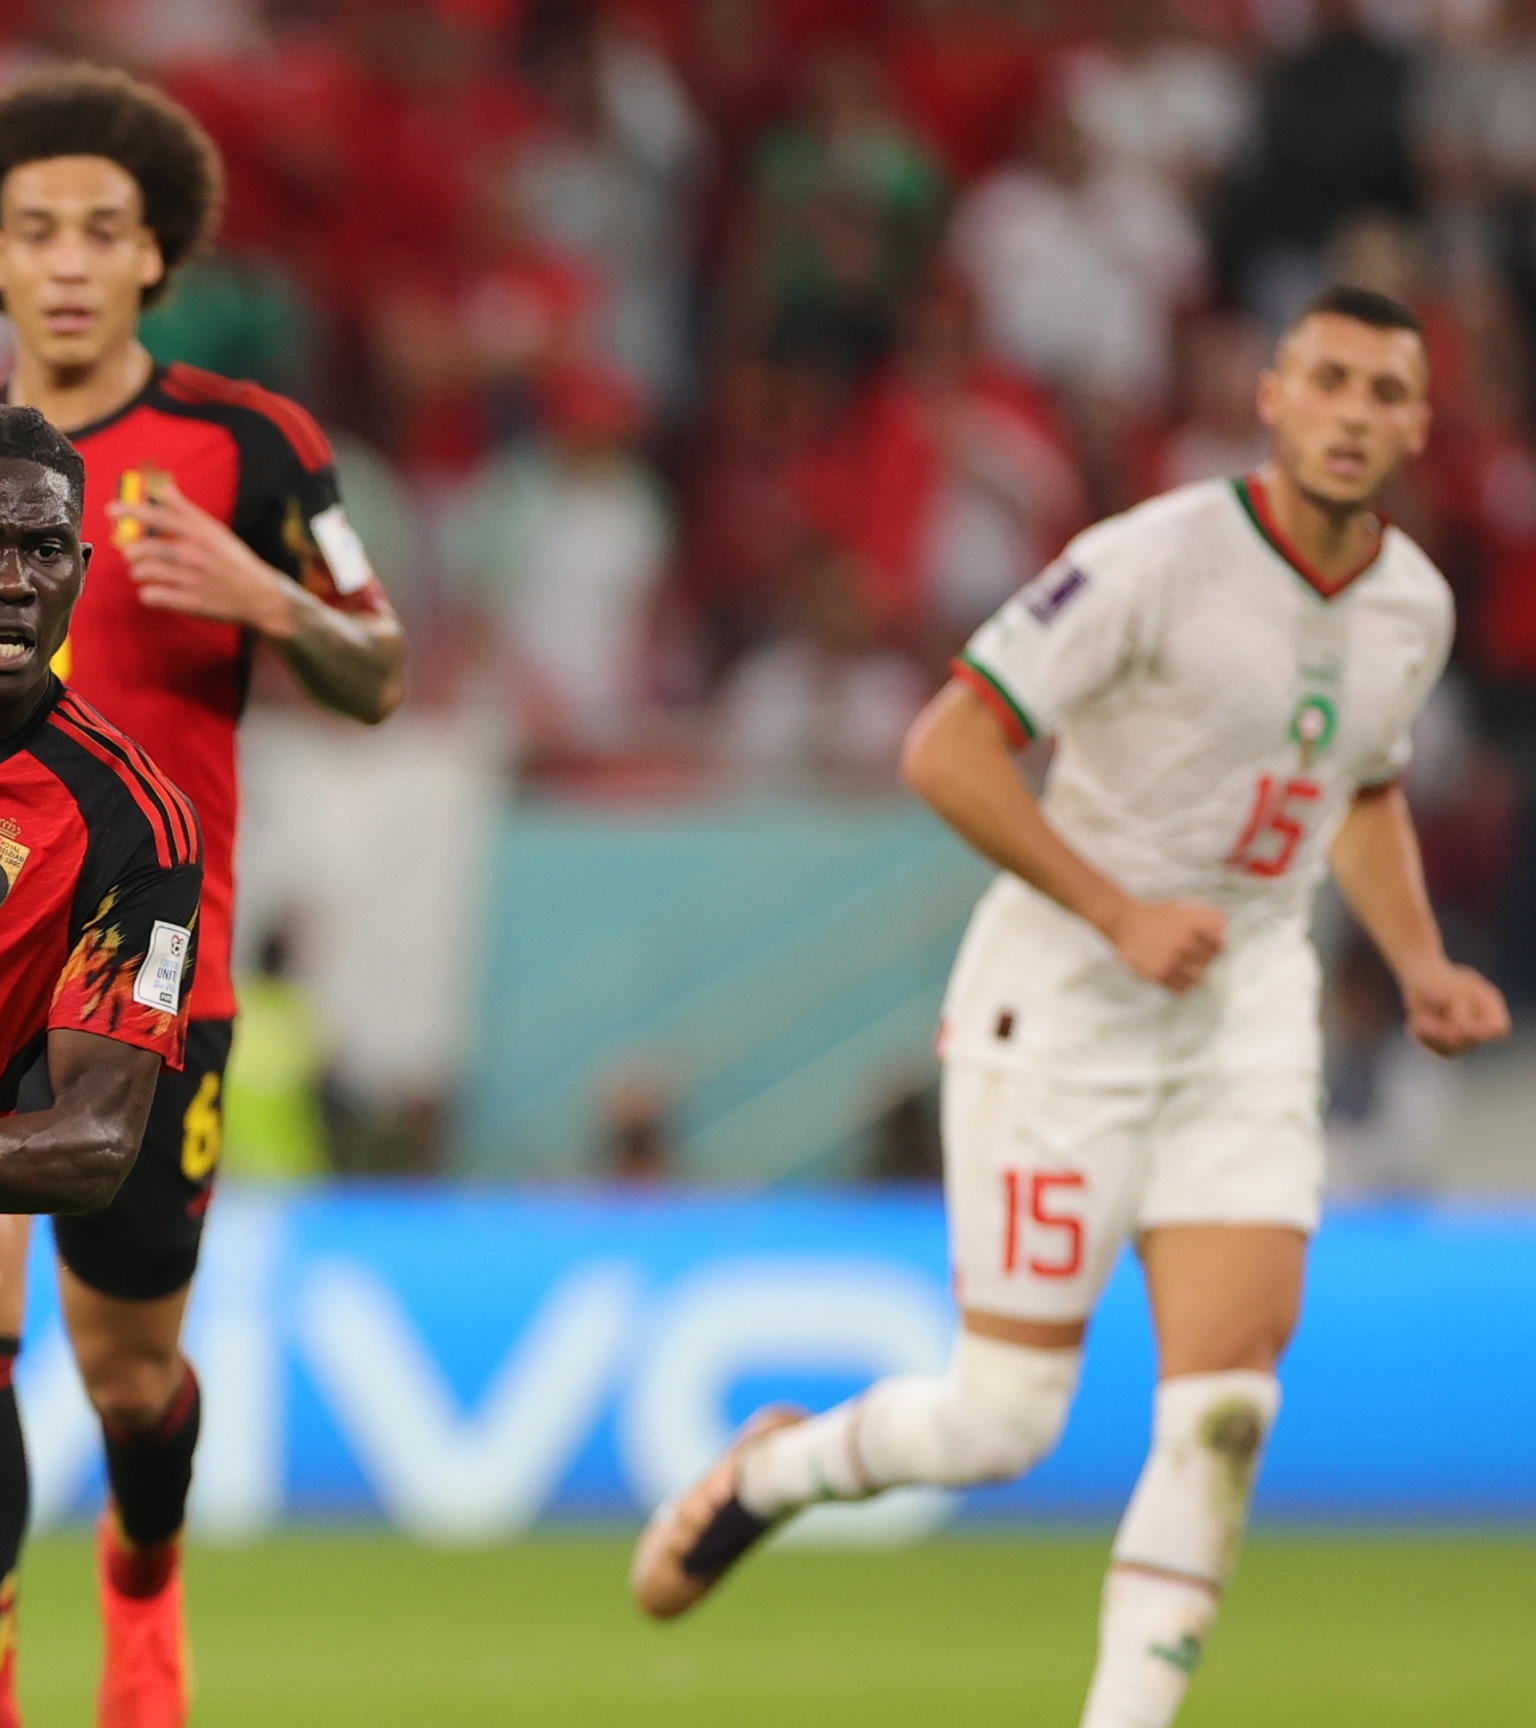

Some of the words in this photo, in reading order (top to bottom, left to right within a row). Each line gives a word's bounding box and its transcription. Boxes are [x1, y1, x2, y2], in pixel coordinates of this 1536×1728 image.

[1224, 772, 1321, 878] 15
[181, 1072, 222, 1180] 6
[1002, 1169, 1085, 1277] 15
